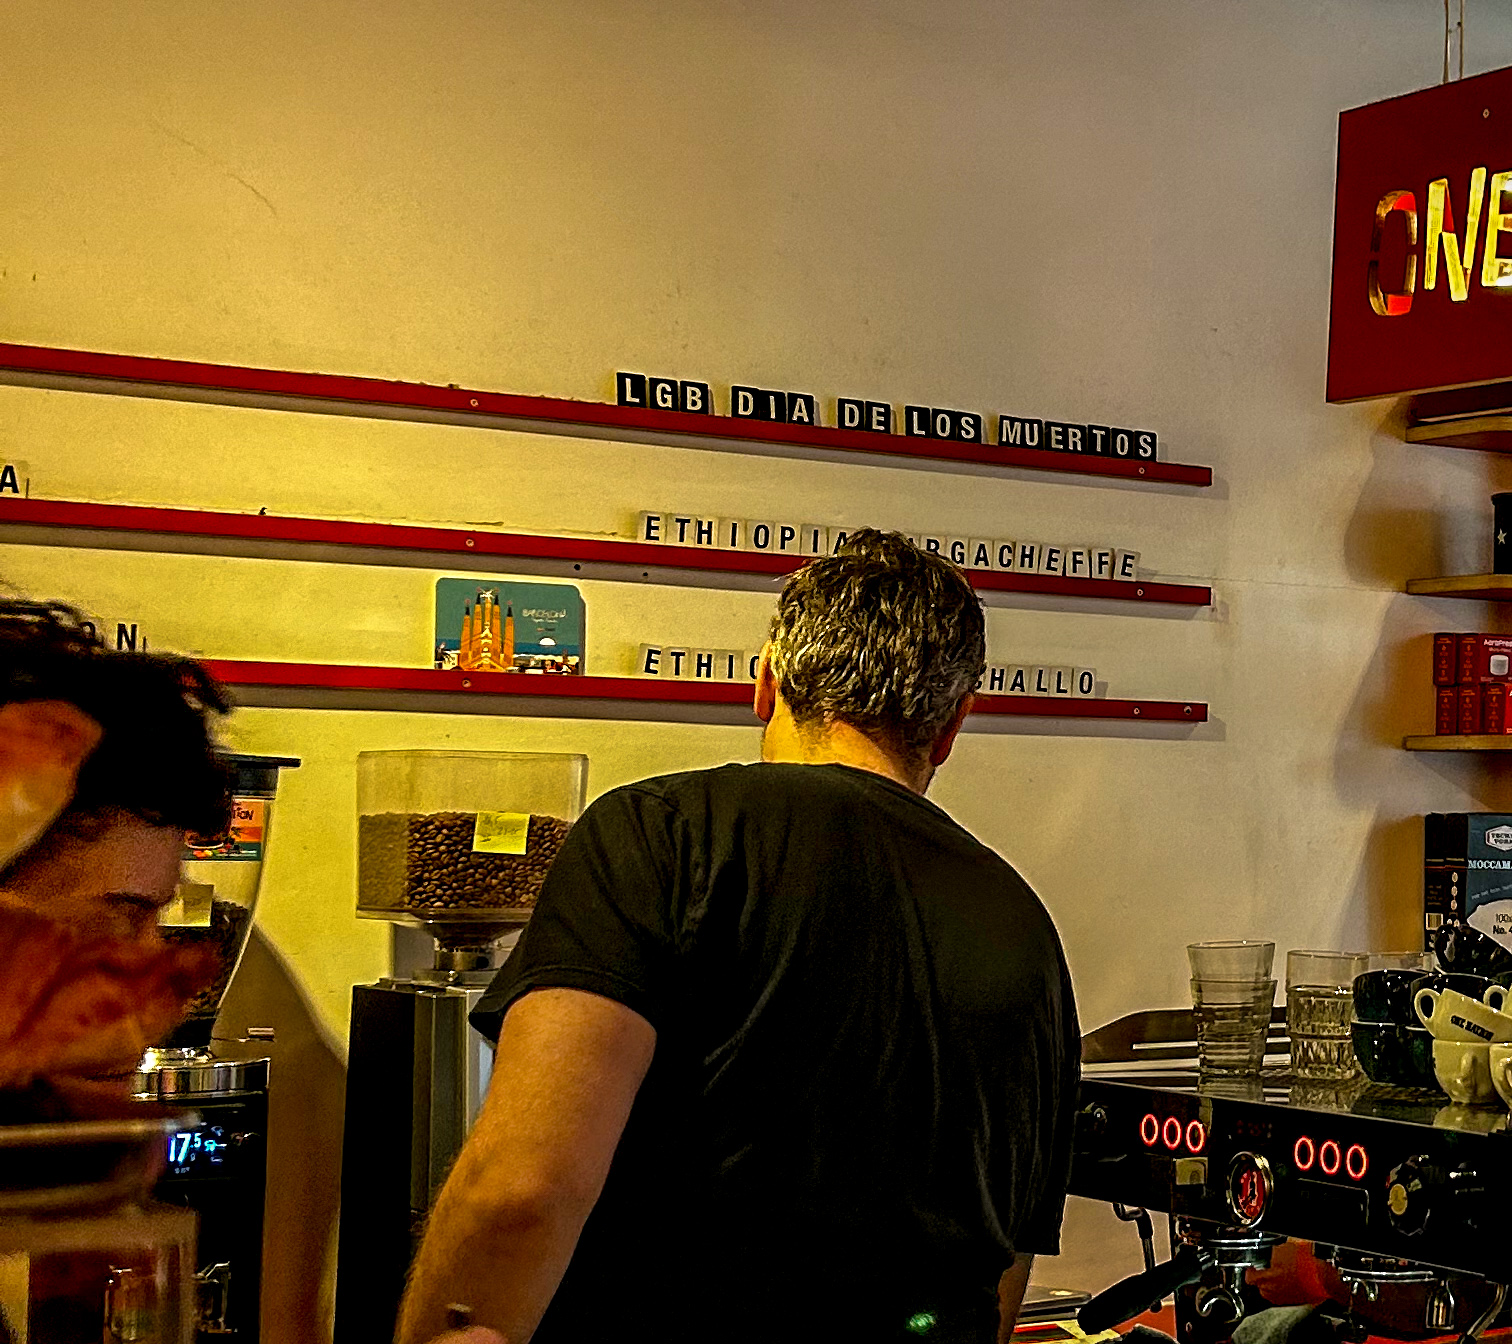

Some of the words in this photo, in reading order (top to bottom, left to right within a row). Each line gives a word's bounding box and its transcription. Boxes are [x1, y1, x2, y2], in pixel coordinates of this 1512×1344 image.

[624, 375, 705, 413] LGB
[736, 389, 811, 424] DIA
[842, 402, 887, 430] DE
[911, 410, 976, 441] LOS
[1001, 420, 1154, 458] MUERTOS
